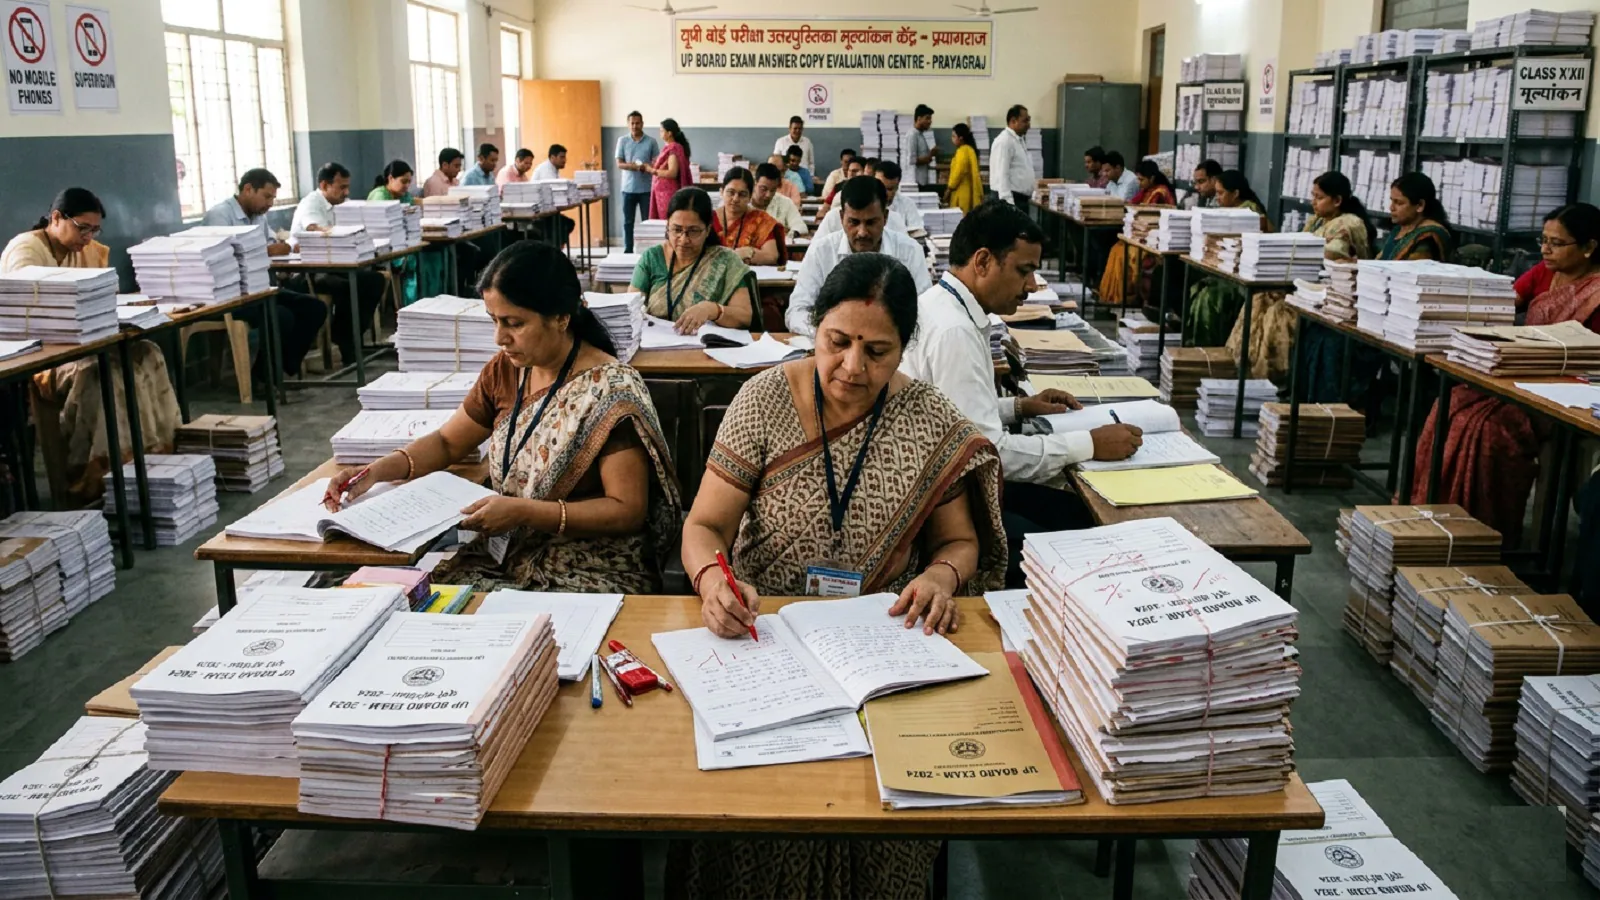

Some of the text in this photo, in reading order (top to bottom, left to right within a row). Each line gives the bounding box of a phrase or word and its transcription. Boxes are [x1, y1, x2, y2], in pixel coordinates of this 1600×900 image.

[681, 53, 693, 68] UP
[696, 53, 727, 68] BOARD
[730, 53, 756, 68] EXAM
[758, 54, 798, 68] ANSWER
[799, 54, 825, 68] COPY
[827, 54, 885, 69] EVALUATION
[887, 54, 925, 69] CENTRE
[932, 55, 987, 70] PRAYAGRAJ
[8, 69, 57, 87] NO MOBILE
[1520, 66, 1556, 80] CLASS
[1519, 83, 1583, 104] मूल्यांकन
[943, 770, 976, 779] EXAM
[1022, 765, 1039, 774] UP
